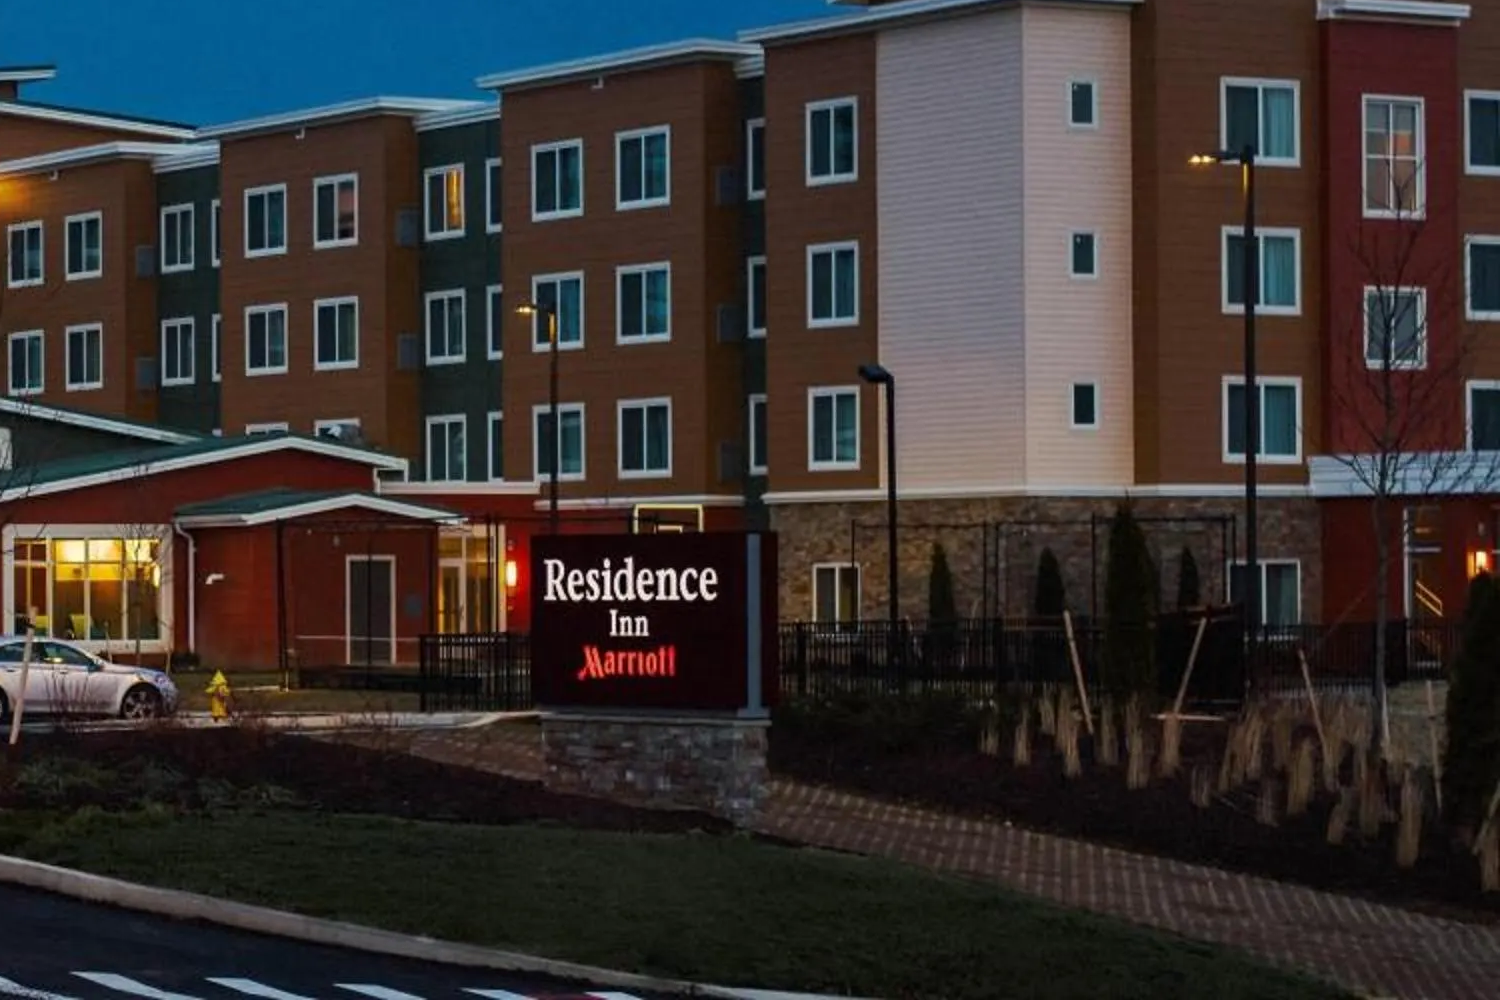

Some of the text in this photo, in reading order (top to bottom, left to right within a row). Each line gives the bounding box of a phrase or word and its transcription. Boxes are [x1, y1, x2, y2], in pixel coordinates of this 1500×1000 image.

[543, 556, 718, 601] Residence
[609, 609, 649, 636] Inn
[577, 645, 676, 680] Marriott
